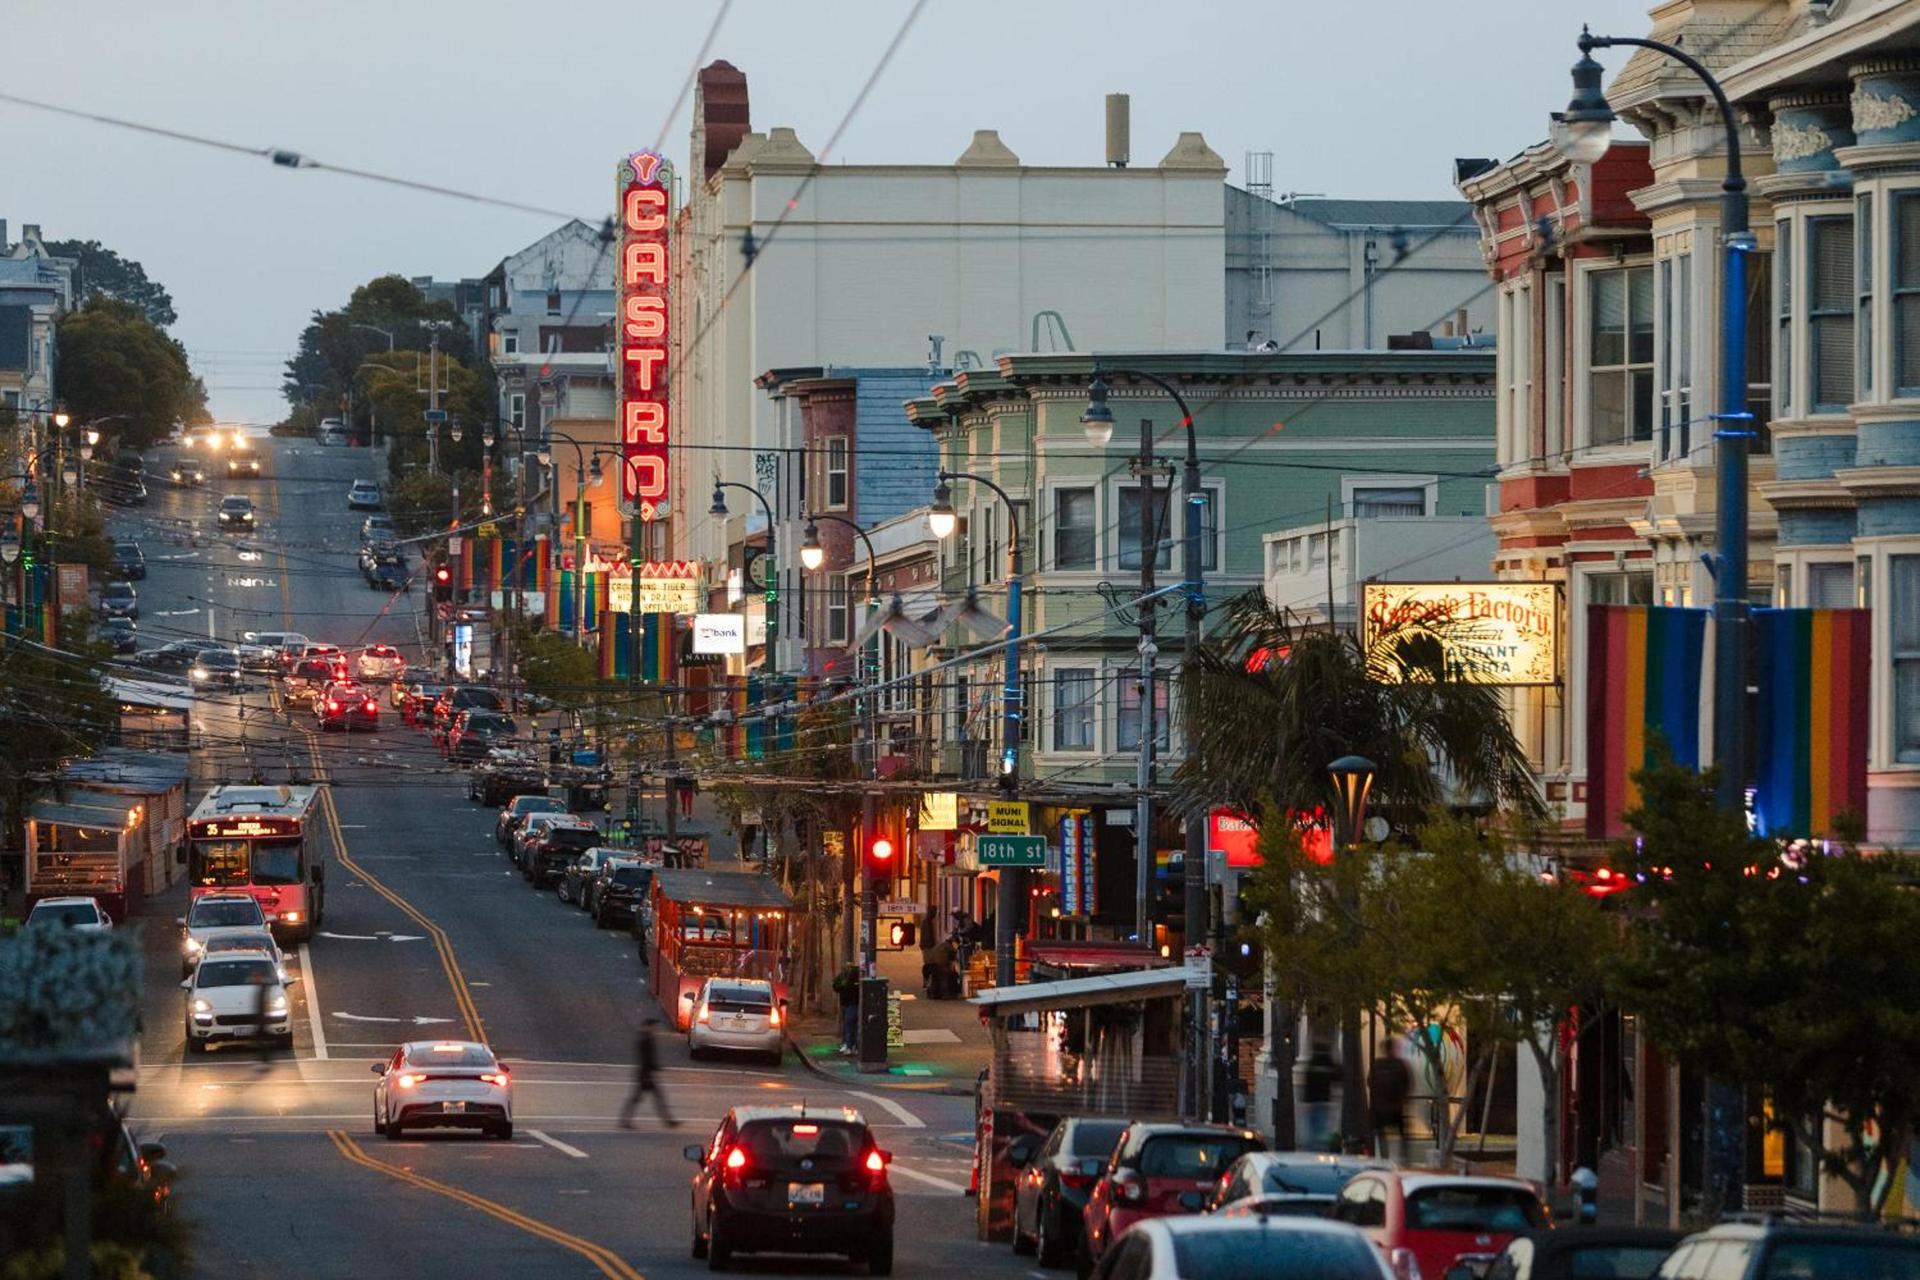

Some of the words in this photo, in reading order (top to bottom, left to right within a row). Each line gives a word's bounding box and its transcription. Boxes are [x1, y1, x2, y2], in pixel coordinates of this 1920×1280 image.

[626, 190, 666, 497] CASTRO
[1468, 592, 1549, 637] Factory
[713, 628, 738, 637] bank
[996, 807, 1022, 816] MUNI
[207, 823, 219, 836] 35
[990, 818, 1026, 828] SIGNAL
[983, 843, 1015, 858] 18th
